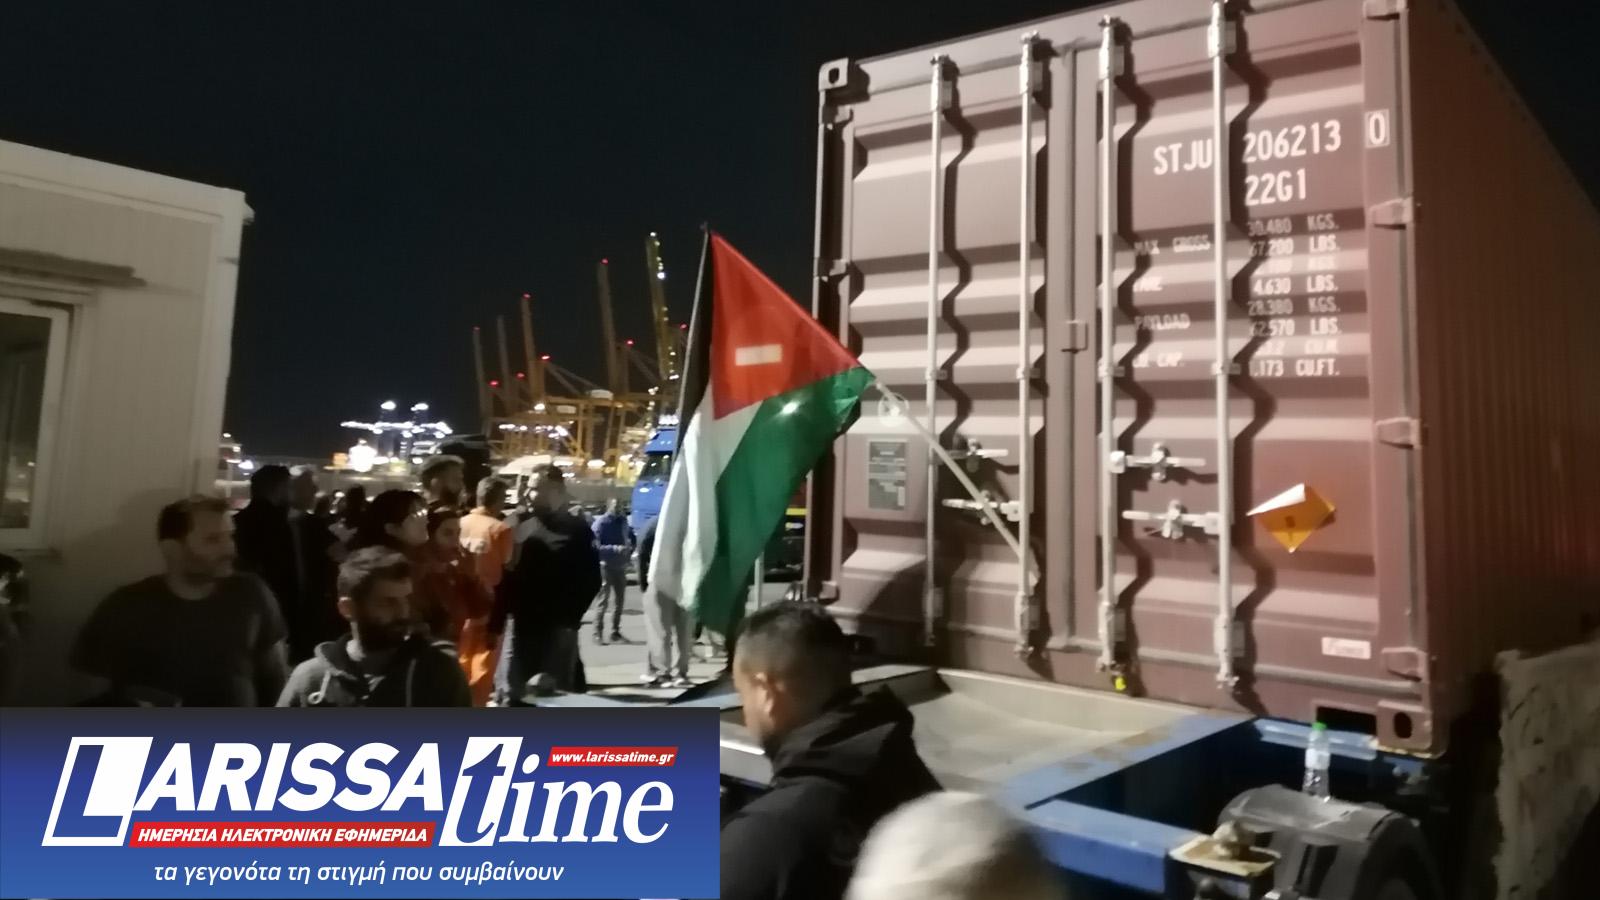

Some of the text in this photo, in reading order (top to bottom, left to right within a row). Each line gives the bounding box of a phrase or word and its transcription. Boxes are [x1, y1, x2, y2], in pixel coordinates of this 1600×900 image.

[1153, 112, 1386, 176] STJU 206213 0
[1244, 168, 1306, 206] 22G1
[1307, 275, 1338, 293] LBS.
